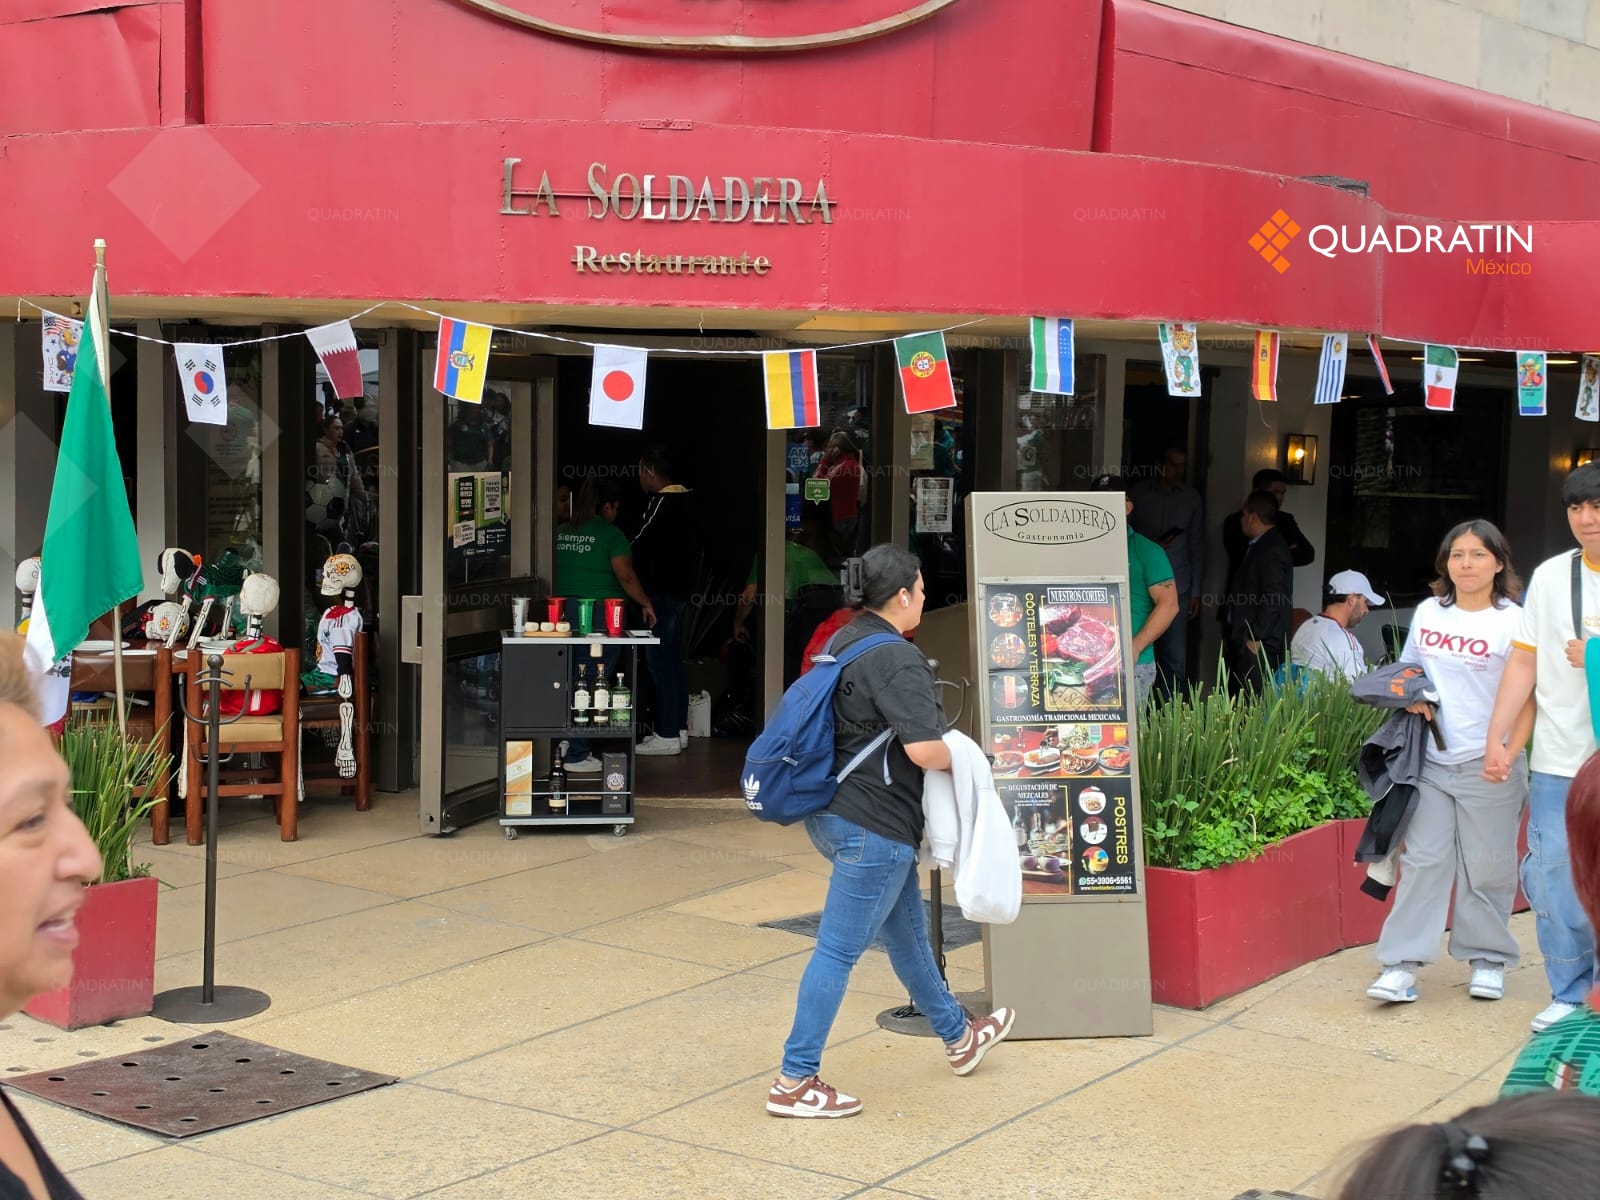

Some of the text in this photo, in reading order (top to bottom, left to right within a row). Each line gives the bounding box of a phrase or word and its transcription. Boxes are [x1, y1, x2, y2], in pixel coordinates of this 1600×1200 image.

[499, 157, 834, 225] LA SOLDADERA
[574, 245, 771, 277] Restaurante
[990, 507, 1111, 532] LA SOLDADERA
[557, 533, 596, 544] Siempre
[1017, 530, 1085, 542] Gastronomía
[556, 543, 592, 554] contigo
[1050, 590, 1081, 602] NUESTROS
[1082, 590, 1106, 602] CORTES
[1025, 592, 1040, 707] CÓCTELES Y TERRAZA
[996, 713, 1121, 722] GASTRONOMÍA TRADICIONAL MEXICANA
[1049, 783, 1058, 791] DE
[1114, 796, 1128, 865] POSTRES
